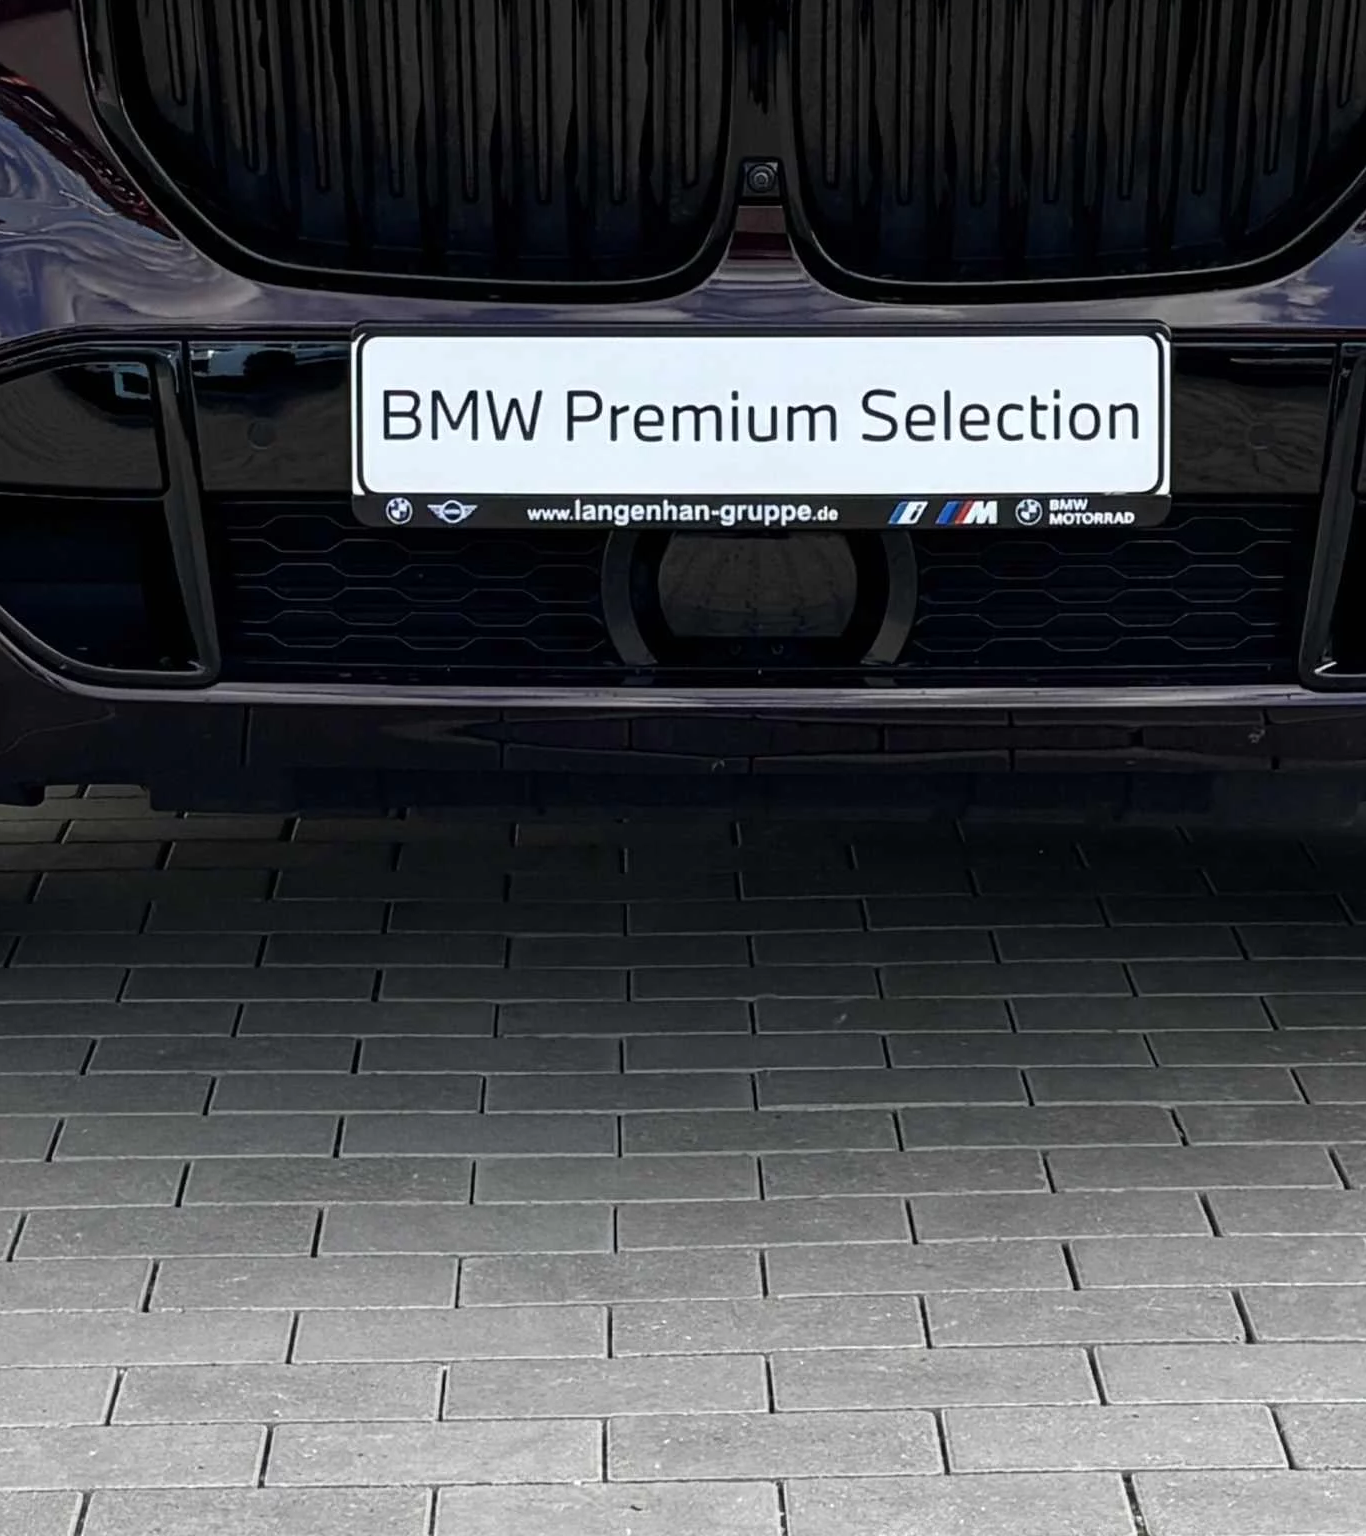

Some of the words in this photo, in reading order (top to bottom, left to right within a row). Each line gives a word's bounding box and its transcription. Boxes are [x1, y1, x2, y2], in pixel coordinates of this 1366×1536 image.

[382, 389, 543, 441] BMW
[566, 389, 837, 443] Premium
[861, 388, 1140, 443] Selection
[526, 498, 839, 527] www.langenhan-gruppe.de
[1048, 498, 1089, 511] BMW
[1048, 511, 1136, 525] MOTORRAD
